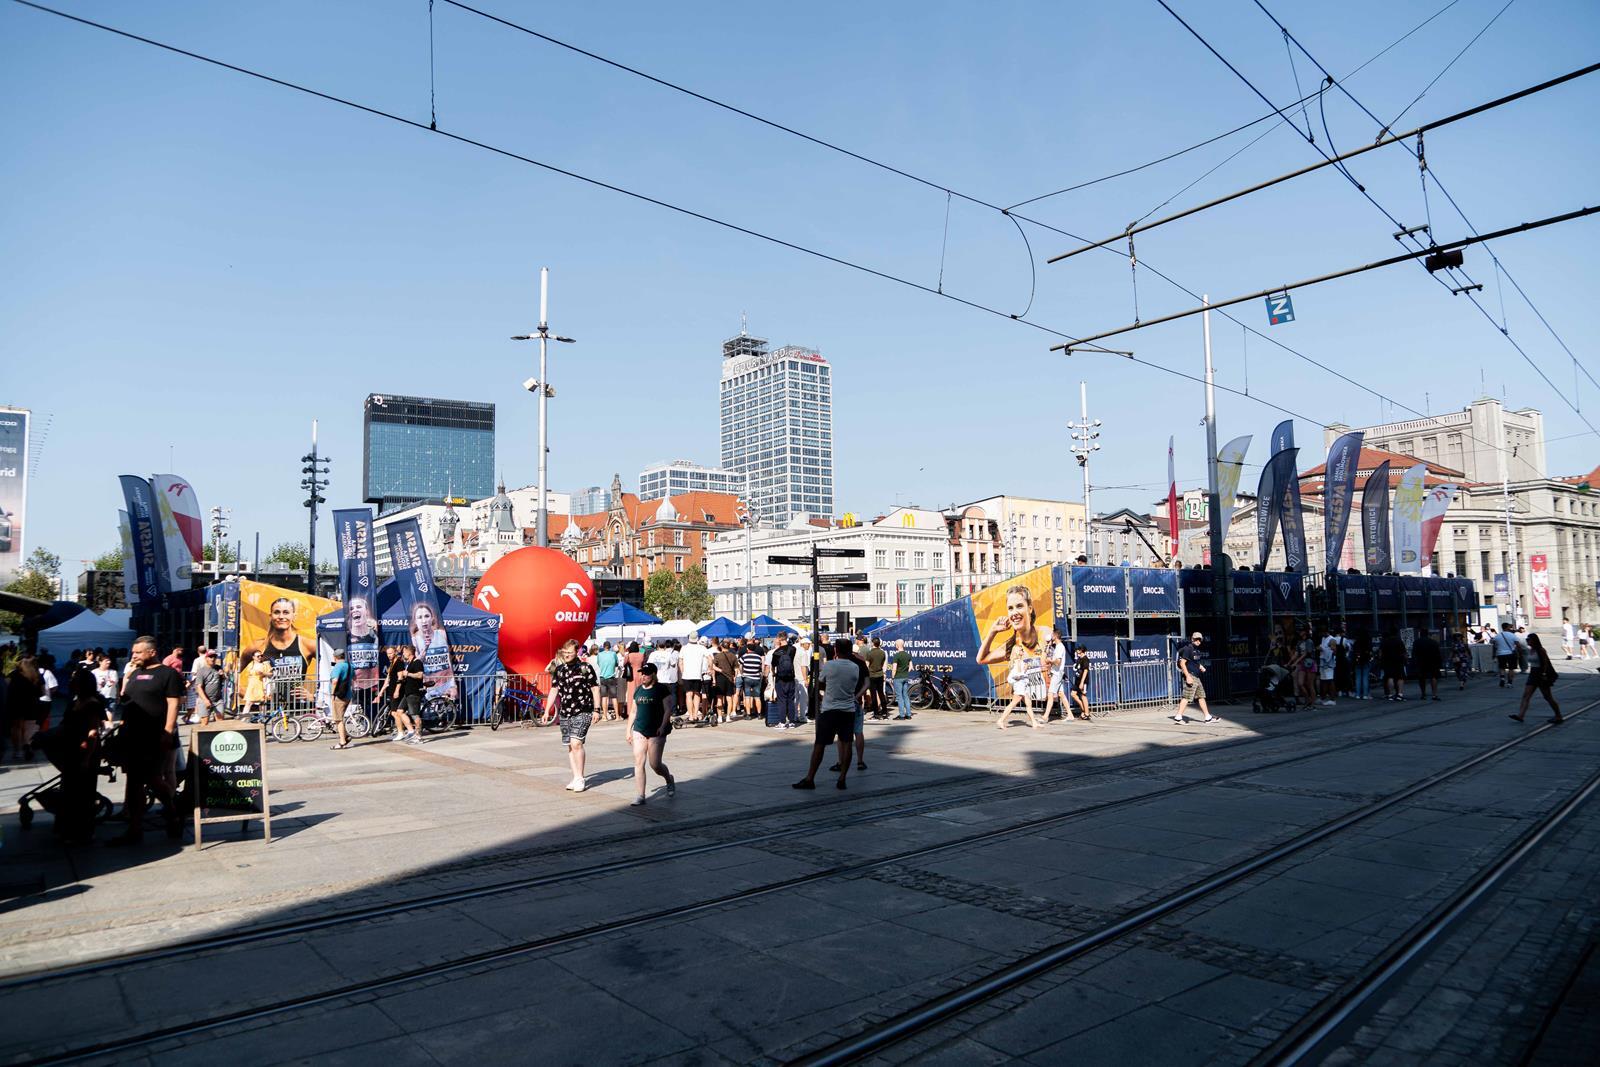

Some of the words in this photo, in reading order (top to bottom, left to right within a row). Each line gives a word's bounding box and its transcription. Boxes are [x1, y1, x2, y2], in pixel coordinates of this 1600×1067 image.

[1259, 495, 1271, 538] KATOWICE
[1083, 585, 1116, 593] SPORTOWE
[1142, 586, 1165, 595] EMOCJE
[1055, 586, 1064, 618] SILESIA
[227, 601, 237, 630] SILESIA
[555, 611, 590, 622] ORLEN
[914, 640, 941, 648] EMOCJE
[918, 650, 967, 658] KATOWICACH!
[215, 743, 243, 752] LODZIO
[209, 765, 232, 774] SMAK
[234, 765, 254, 774] DNIA
